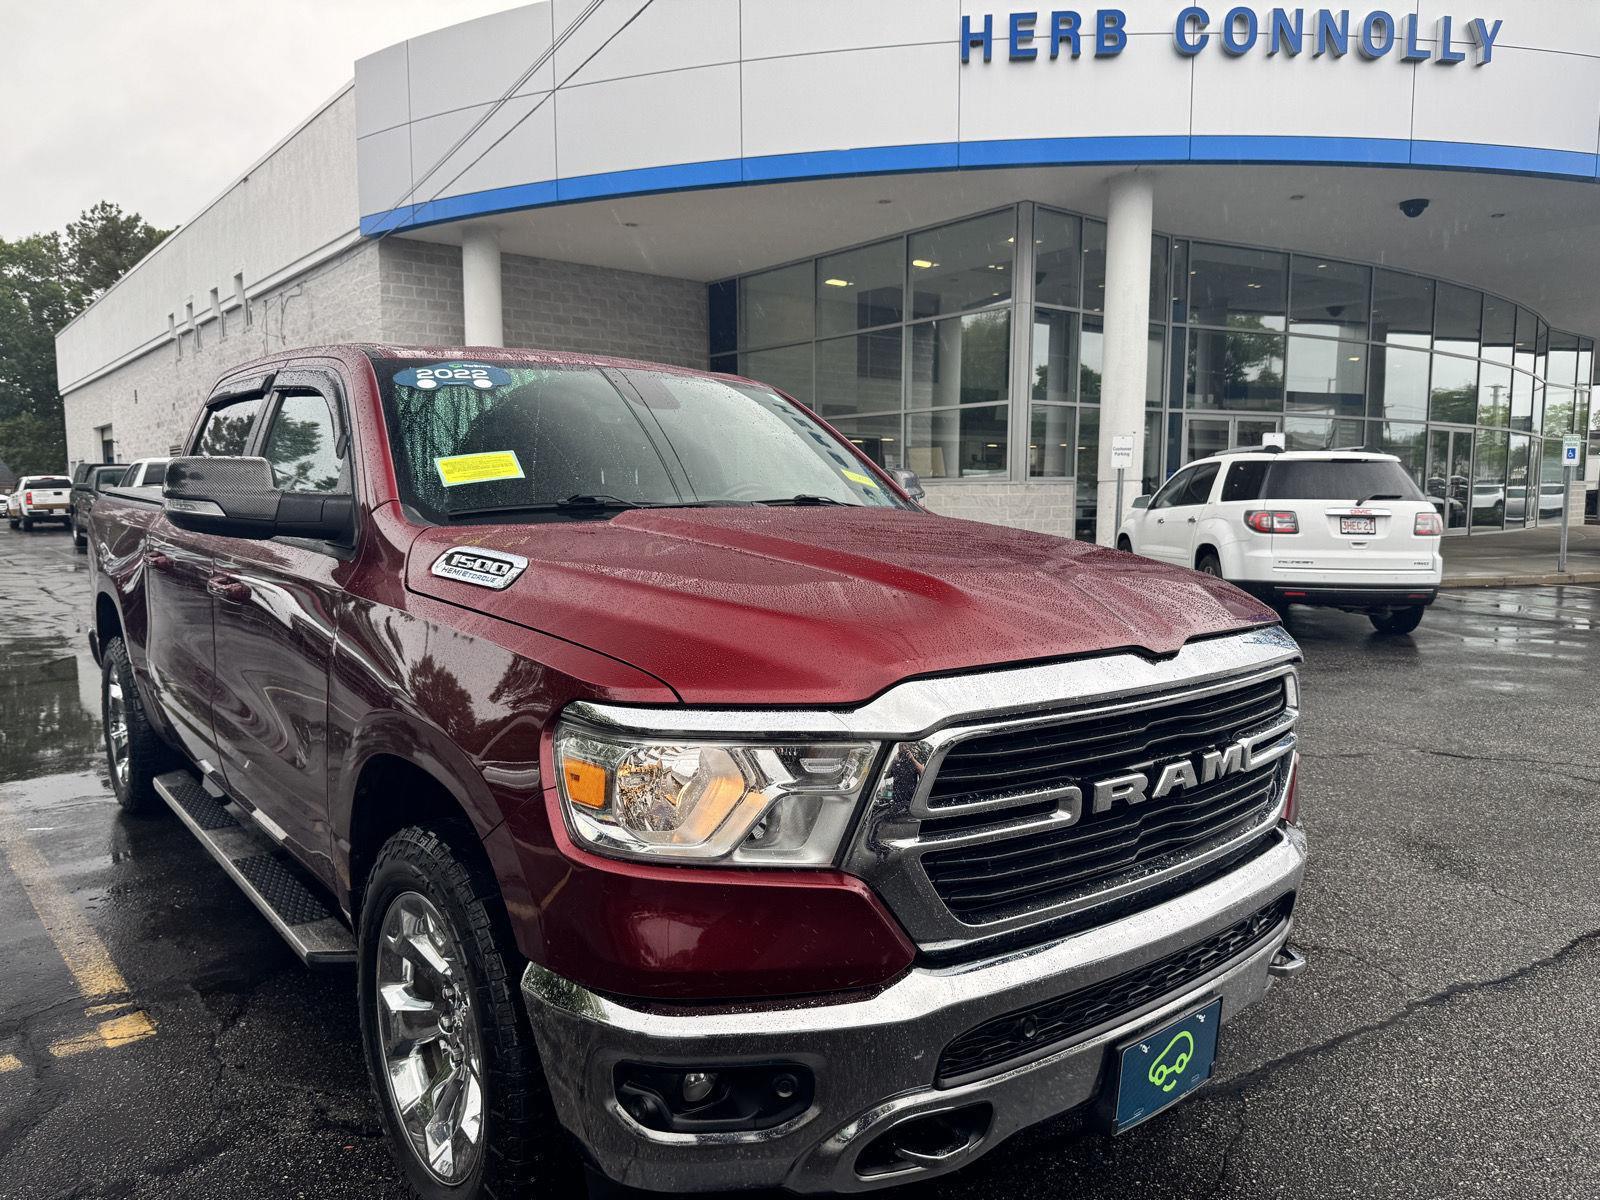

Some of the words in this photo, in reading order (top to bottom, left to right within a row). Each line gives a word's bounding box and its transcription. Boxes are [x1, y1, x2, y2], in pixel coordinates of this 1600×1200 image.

[961, 9, 1128, 63] HERB
[1173, 7, 1503, 66] CONNOLLY
[416, 369, 490, 379] 2022
[442, 566, 462, 575] HEMI
[451, 554, 511, 575] 1500
[1093, 744, 1242, 814] RAM
